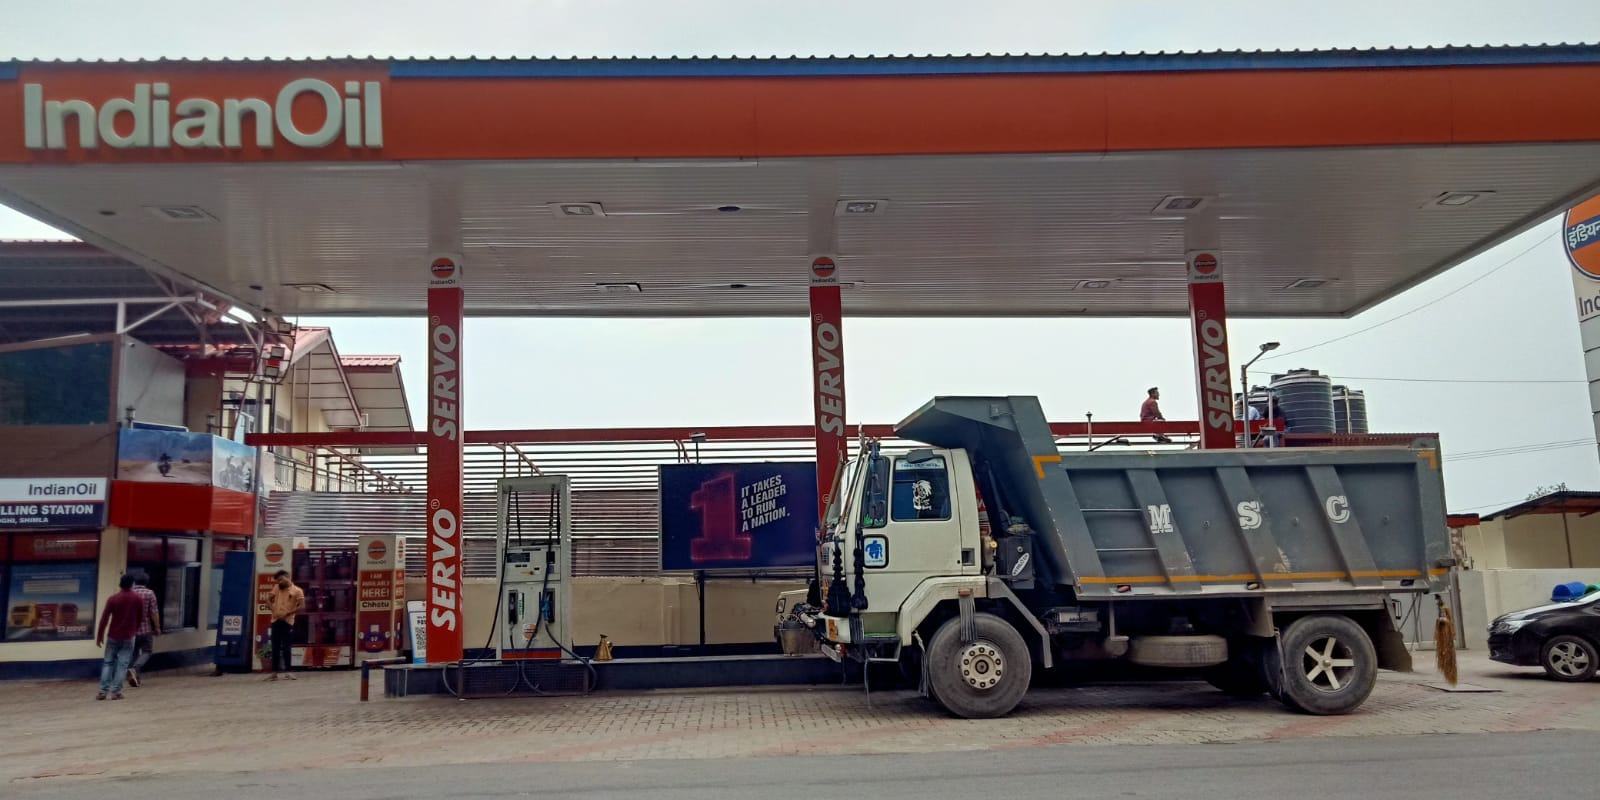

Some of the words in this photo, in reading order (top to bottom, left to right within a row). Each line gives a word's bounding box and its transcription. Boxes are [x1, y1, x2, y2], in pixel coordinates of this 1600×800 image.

[24, 78, 383, 148] IndianOil
[28, 483, 97, 495] IndianOil
[741, 486, 750, 498] IT
[752, 474, 782, 493] TAKES
[741, 498, 749, 510] A
[751, 484, 786, 506] LEADER
[41, 504, 94, 515] STATION
[741, 507, 753, 520] TO
[756, 499, 776, 516] RUN
[742, 520, 749, 532] A
[751, 506, 791, 528] NATION.
[1148, 504, 1174, 534] M
[1237, 501, 1262, 530] S
[1325, 495, 1350, 524] C
[362, 588, 390, 598] HERE!
[361, 601, 390, 609] Chhotu
